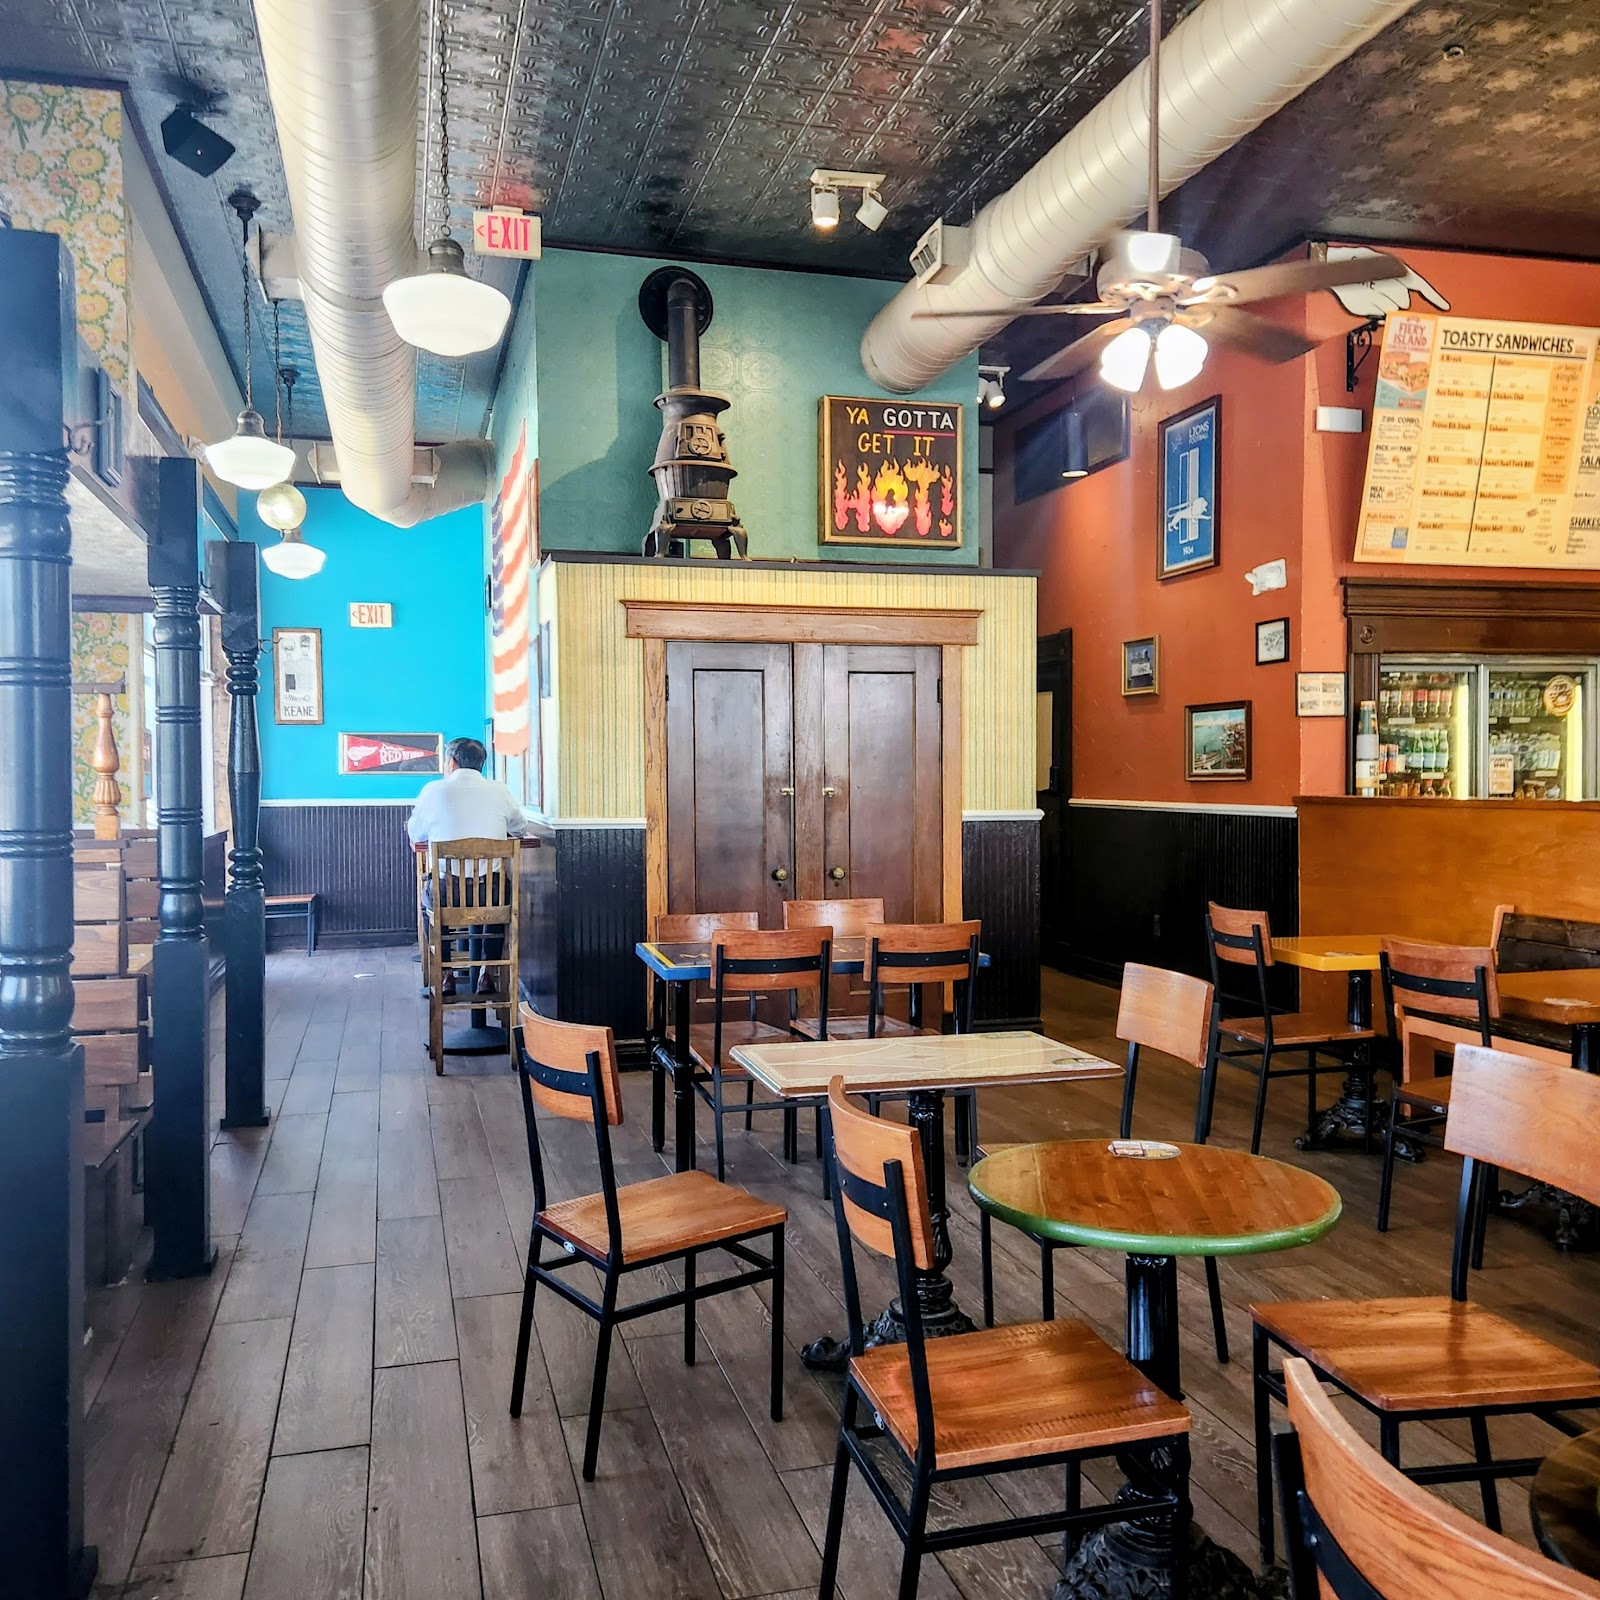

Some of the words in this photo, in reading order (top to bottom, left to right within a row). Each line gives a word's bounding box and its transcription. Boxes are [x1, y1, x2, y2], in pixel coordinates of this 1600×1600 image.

[488, 215, 531, 251] EXIT
[1399, 322, 1425, 336] FIERY
[1393, 333, 1428, 346] ISLAND
[1442, 329, 1493, 348] TOASTY
[1496, 333, 1575, 354] SANDWICHES
[1493, 392, 1513, 400] Chicken
[846, 406, 869, 425] YA
[883, 408, 954, 430] GOTTA
[1587, 405, 1600, 416] SO
[1188, 420, 1210, 438] LIONS
[858, 432, 895, 454] GET
[913, 436, 935, 456] IT
[834, 457, 954, 537] HOT!
[358, 604, 386, 624] EXIT
[284, 705, 314, 717] KEANE
[379, 749, 402, 766] RED
